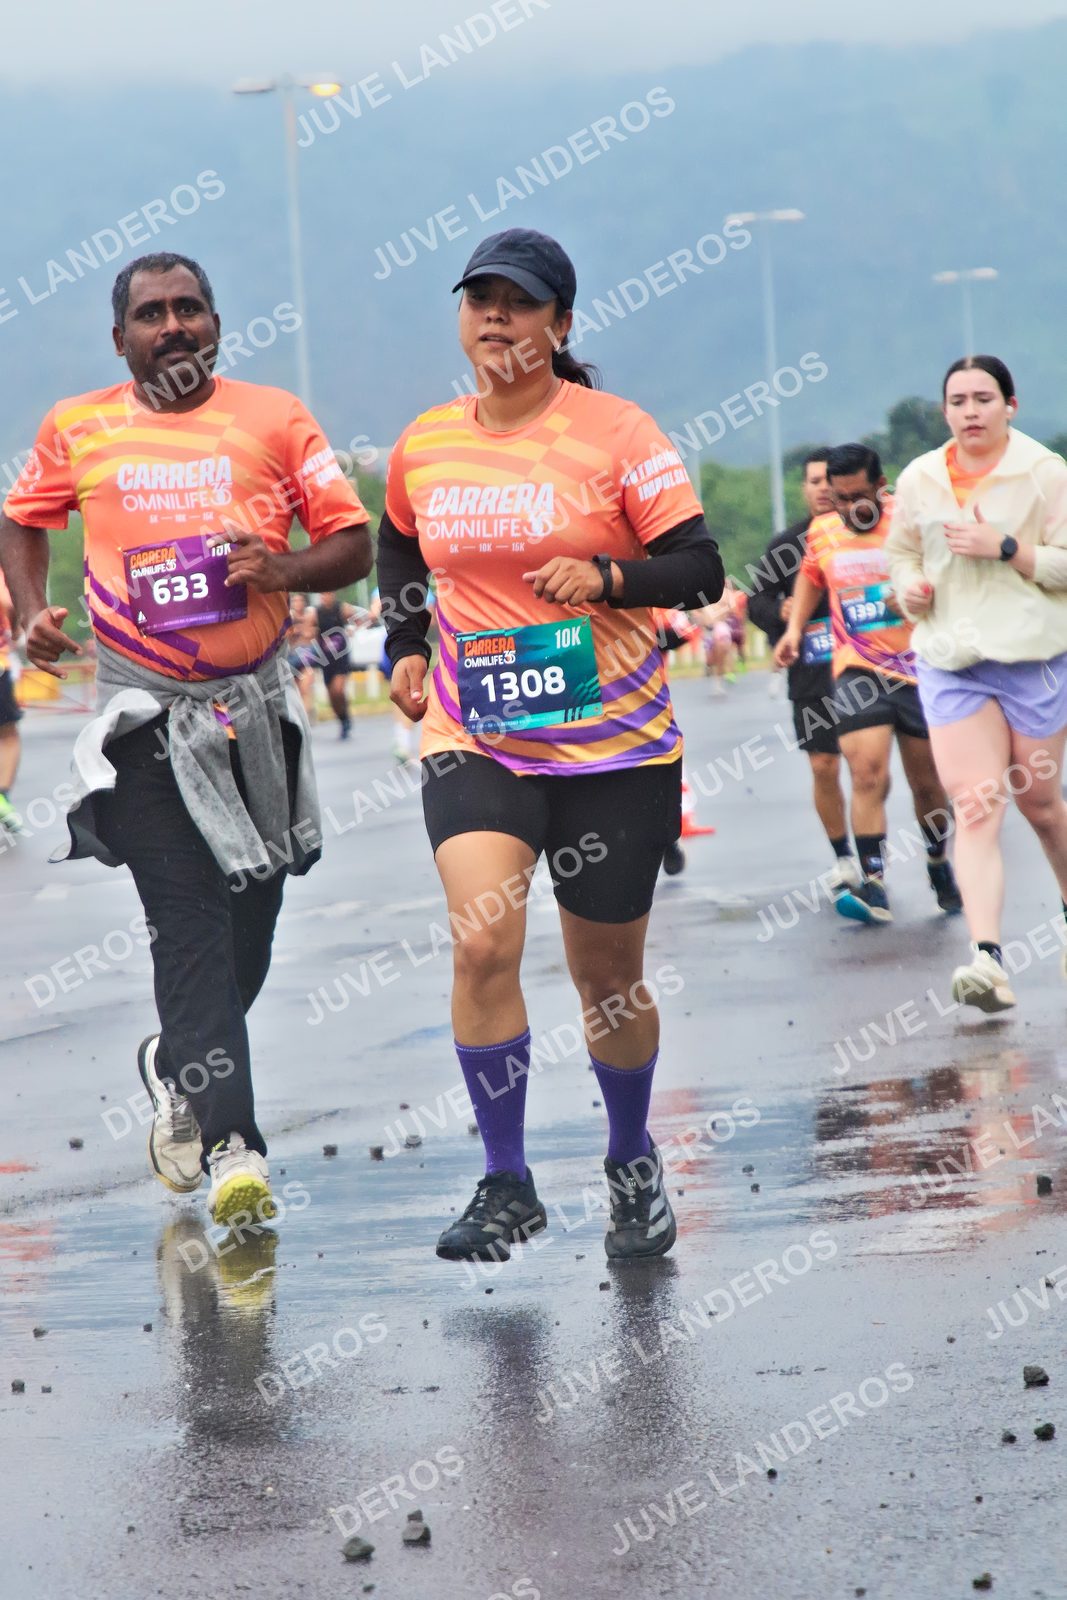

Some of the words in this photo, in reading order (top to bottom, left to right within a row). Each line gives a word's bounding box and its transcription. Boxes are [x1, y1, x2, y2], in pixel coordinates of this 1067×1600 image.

[118, 456, 232, 491] CARRERA
[123, 491, 209, 512] OMNILIFE
[426, 482, 554, 518] CARRERA
[426, 518, 522, 540] OMNILIFE
[130, 547, 176, 570] CARRERA
[152, 572, 209, 605] 633
[464, 636, 516, 657] CARRERA
[554, 626, 582, 650] 10K
[464, 654, 504, 668] OMNILIFE
[480, 666, 566, 702] 1308
